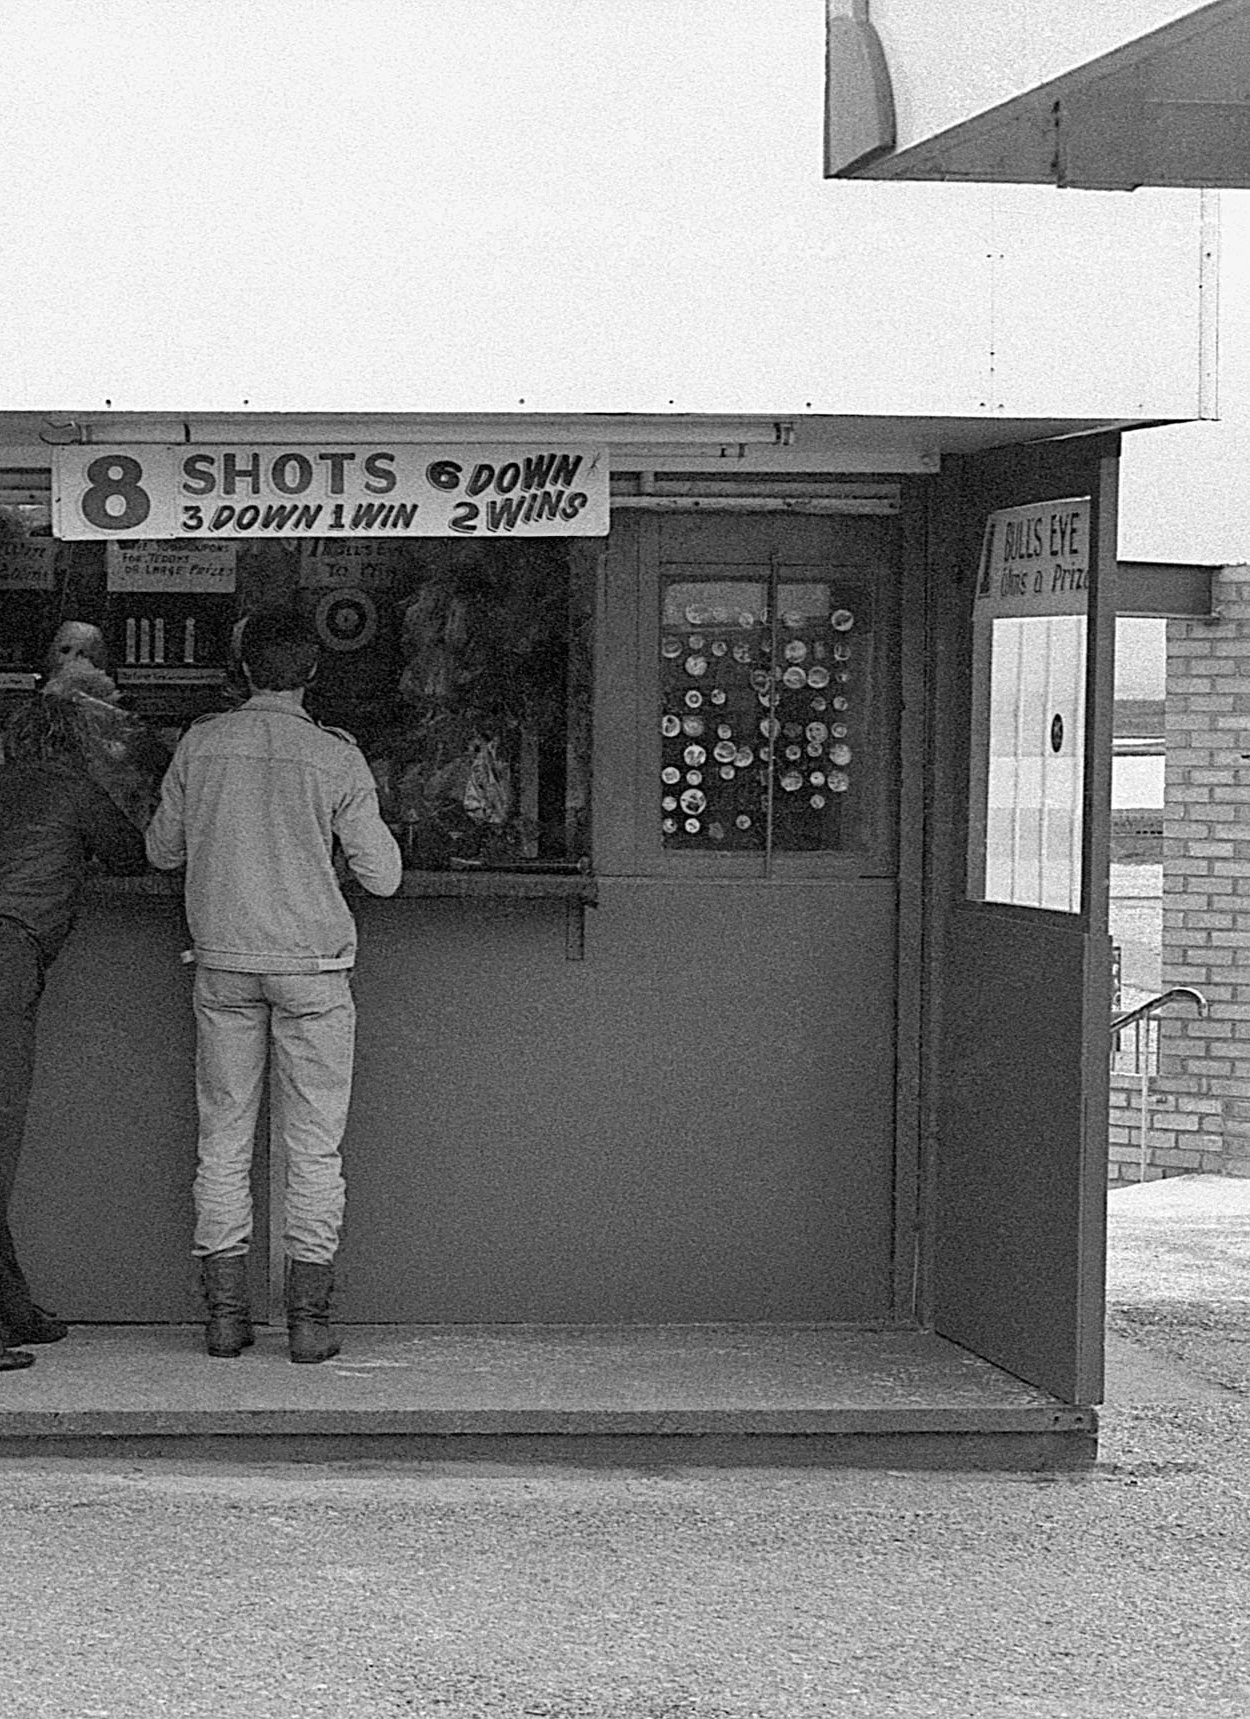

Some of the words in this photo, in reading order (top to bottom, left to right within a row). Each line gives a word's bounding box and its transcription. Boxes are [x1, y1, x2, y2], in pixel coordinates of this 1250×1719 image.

[81, 454, 151, 530] 8
[182, 452, 397, 496] SHOTS
[425, 460, 463, 492] 6
[465, 453, 583, 497] DOWN
[182, 505, 204, 532] 3
[208, 504, 323, 532] DOWN
[328, 504, 345, 530] 1
[349, 502, 419, 530] WIN
[449, 501, 480, 534] 2
[486, 490, 588, 533] WINS
[1004, 517, 1043, 562] BULLS
[1050, 511, 1080, 556] EYE
